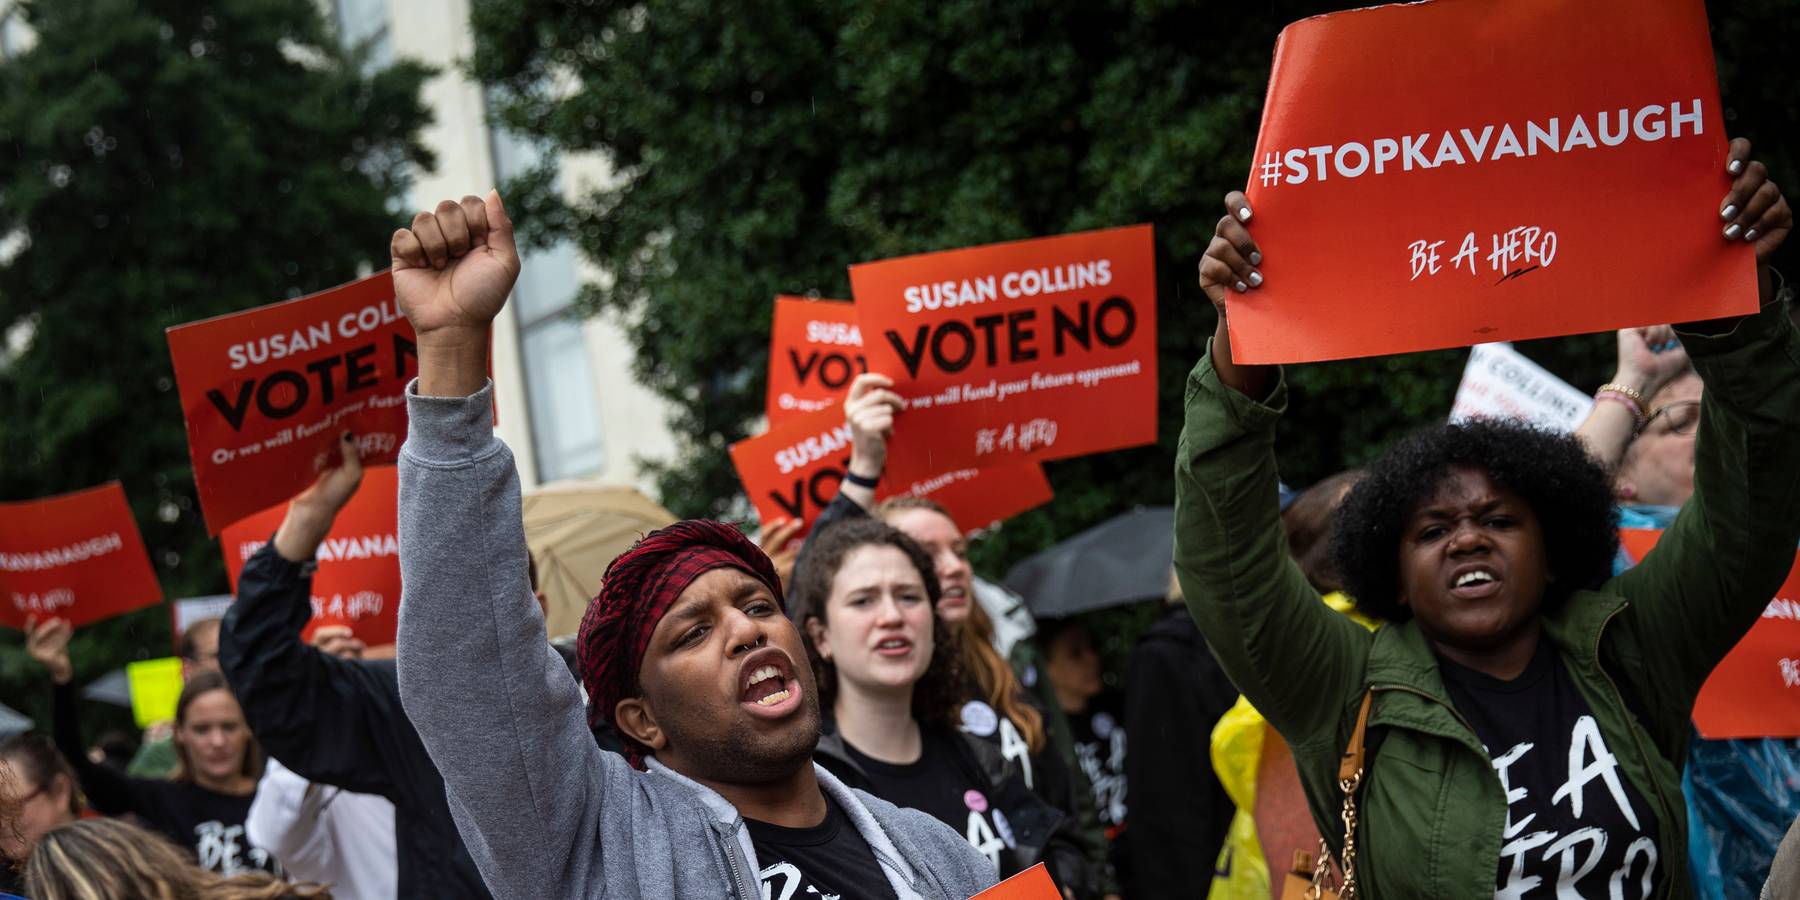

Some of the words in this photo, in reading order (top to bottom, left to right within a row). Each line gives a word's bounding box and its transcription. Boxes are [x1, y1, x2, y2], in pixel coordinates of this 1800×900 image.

[1261, 99, 1704, 187] #STOPKAVANAUGH
[1408, 239, 1445, 281] BE
[1450, 232, 1479, 276] A
[1487, 226, 1558, 277] HERO
[904, 275, 997, 313] SUSAN
[1001, 259, 1112, 298] COLLINS
[228, 321, 332, 370] SUSAN
[884, 310, 1038, 380] VOTE
[1052, 296, 1137, 357] NO
[206, 344, 378, 433] VOTE
[934, 387, 960, 406] will
[962, 380, 996, 403] fund
[997, 379, 1029, 401] your
[1031, 371, 1074, 392] future
[1076, 360, 1141, 389] opponent
[212, 447, 236, 465] Or
[239, 442, 261, 456] we
[264, 428, 293, 449] will
[296, 413, 331, 439] fund
[999, 423, 1016, 452] A
[1552, 715, 1641, 831] A
